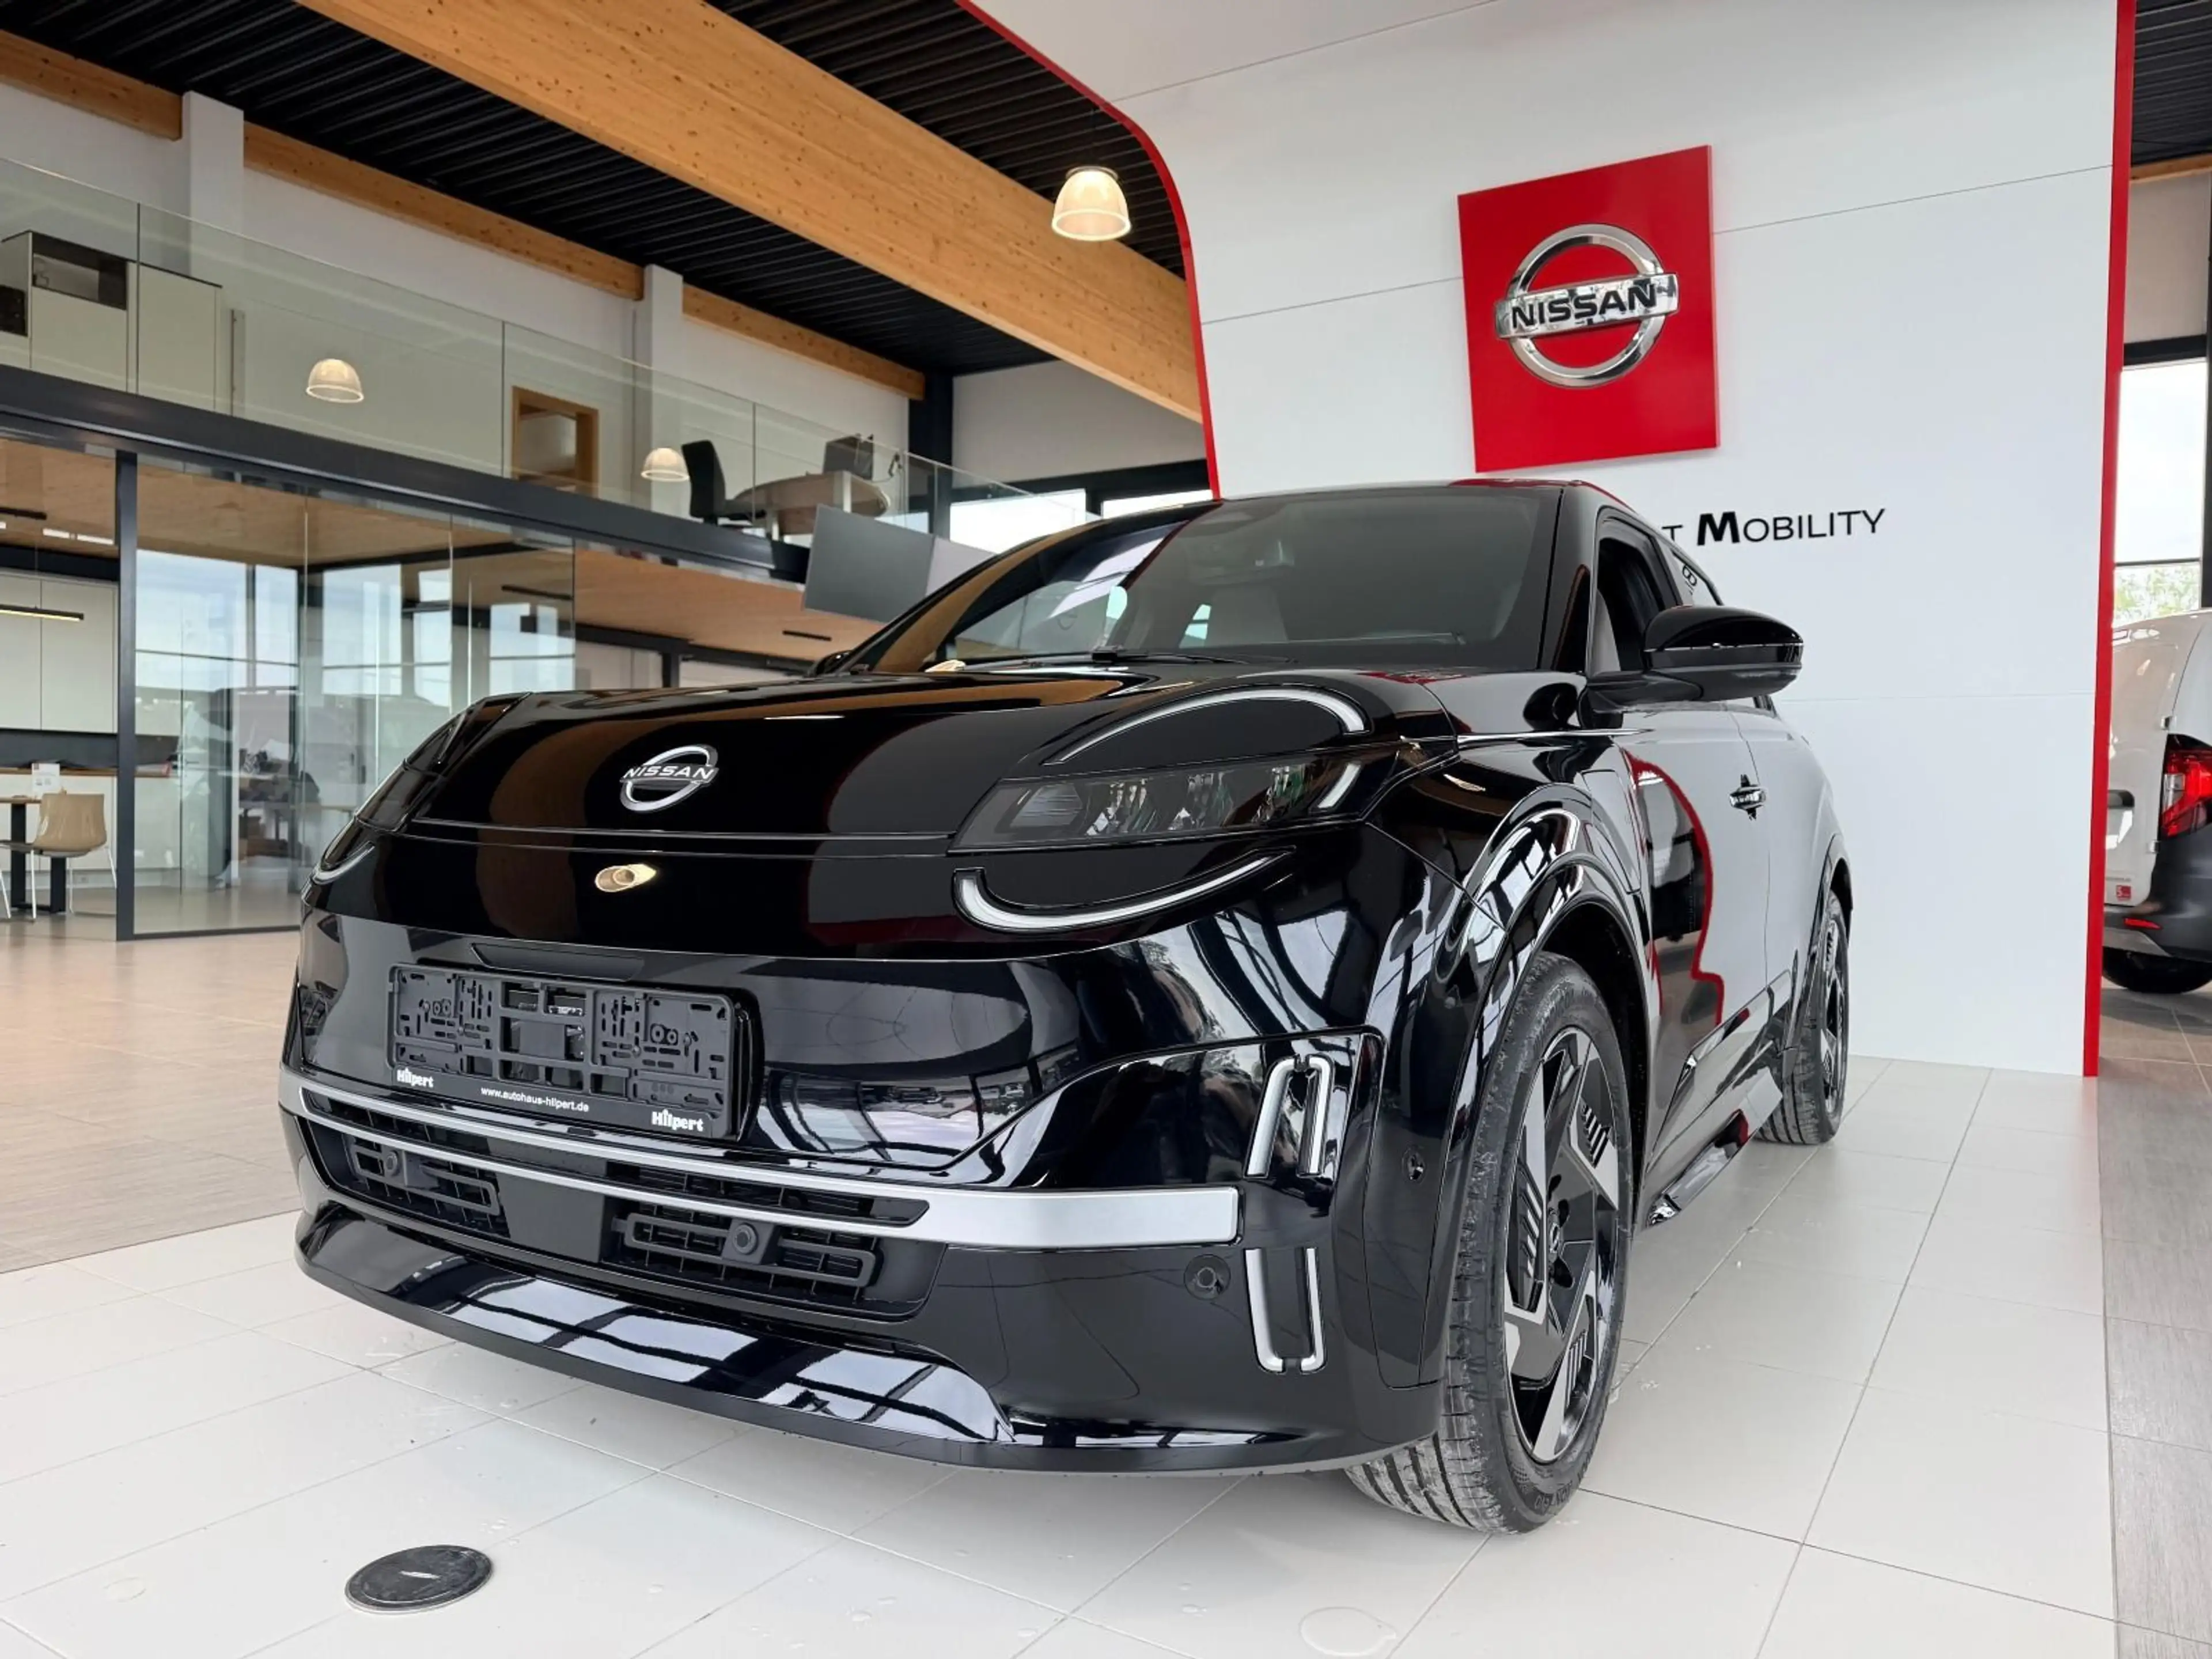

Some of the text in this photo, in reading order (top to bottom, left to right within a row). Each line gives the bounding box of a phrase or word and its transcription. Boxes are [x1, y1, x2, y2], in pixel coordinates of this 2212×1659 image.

[1512, 282, 1657, 329] NISSAN
[1697, 508, 1885, 545] MOBILITY
[623, 765, 715, 780] NISSAN
[396, 1068, 434, 1087] Hilpert
[480, 1086, 589, 1112] www.autohaus-hilpert.de
[651, 1108, 704, 1132] Hilpert
